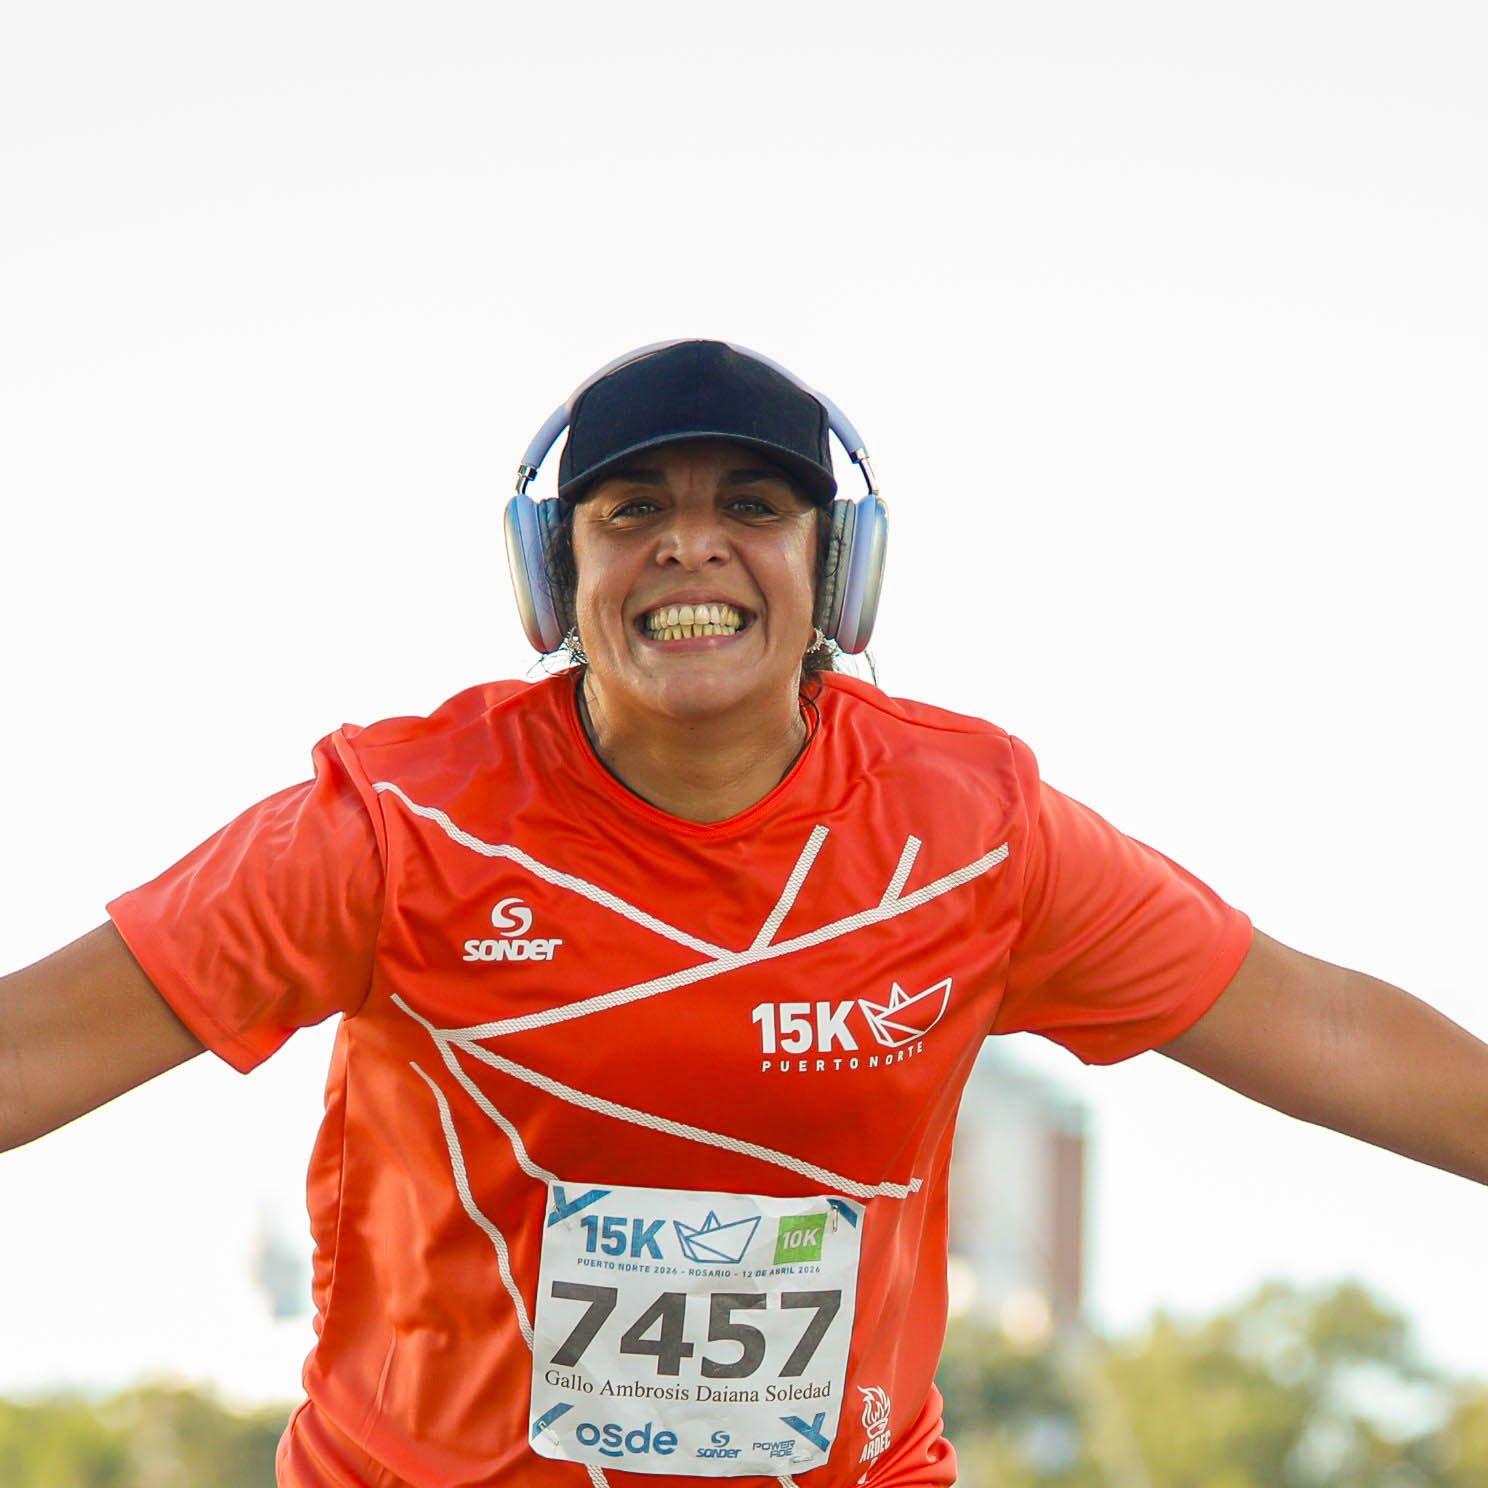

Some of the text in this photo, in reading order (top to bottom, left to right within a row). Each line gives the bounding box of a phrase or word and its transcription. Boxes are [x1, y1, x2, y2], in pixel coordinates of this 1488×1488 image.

[752, 1000, 859, 1054] 15K
[762, 1041, 923, 1072] PUERTO NORTE
[580, 1215, 666, 1259] 15K
[783, 1228, 821, 1249] 10K
[577, 1258, 615, 1270] PUERTO
[618, 1263, 650, 1273] NORTE
[688, 1268, 731, 1277] ROSARIO
[743, 1270, 752, 1278] 12
[755, 1269, 766, 1277] DE
[768, 1265, 794, 1276] ABRIL
[798, 1264, 821, 1274] 2026
[550, 1281, 841, 1379] 7457
[545, 1369, 831, 1403] Gallo Ambrosis Daiana Soledad
[576, 1422, 679, 1455] osde
[752, 1440, 796, 1450] POWER
[859, 1430, 891, 1463] ARDEC
